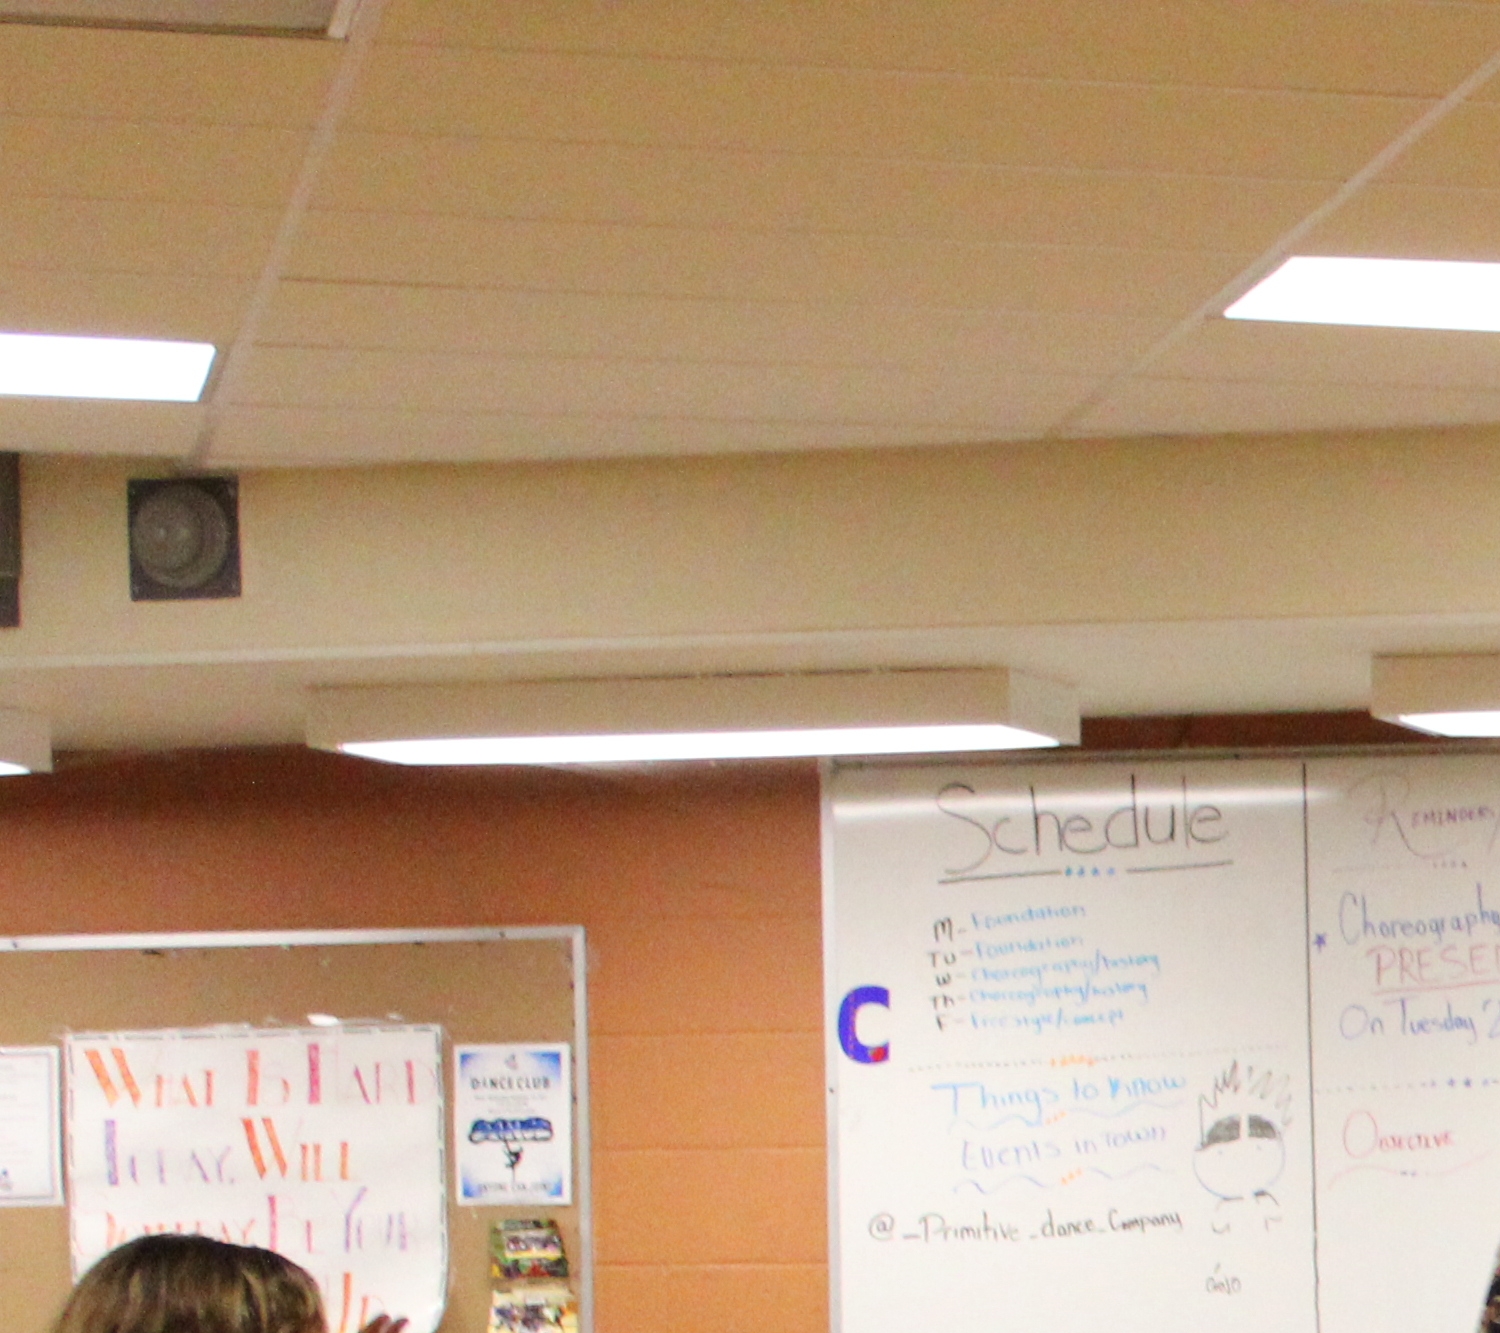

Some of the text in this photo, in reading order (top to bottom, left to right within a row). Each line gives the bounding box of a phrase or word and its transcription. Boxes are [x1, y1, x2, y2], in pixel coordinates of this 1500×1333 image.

[936, 773, 1229, 875] Schedule
[971, 904, 1087, 931] Foundation
[975, 935, 1084, 960] Foundation
[837, 984, 891, 1064] C
[1340, 1003, 1384, 1040] On
[1383, 997, 1478, 1045] Tuesday
[931, 1080, 1059, 1127] Things
[1073, 1076, 1099, 1101] to
[961, 1138, 1061, 1171] Events
[1074, 1133, 1098, 1154] in
